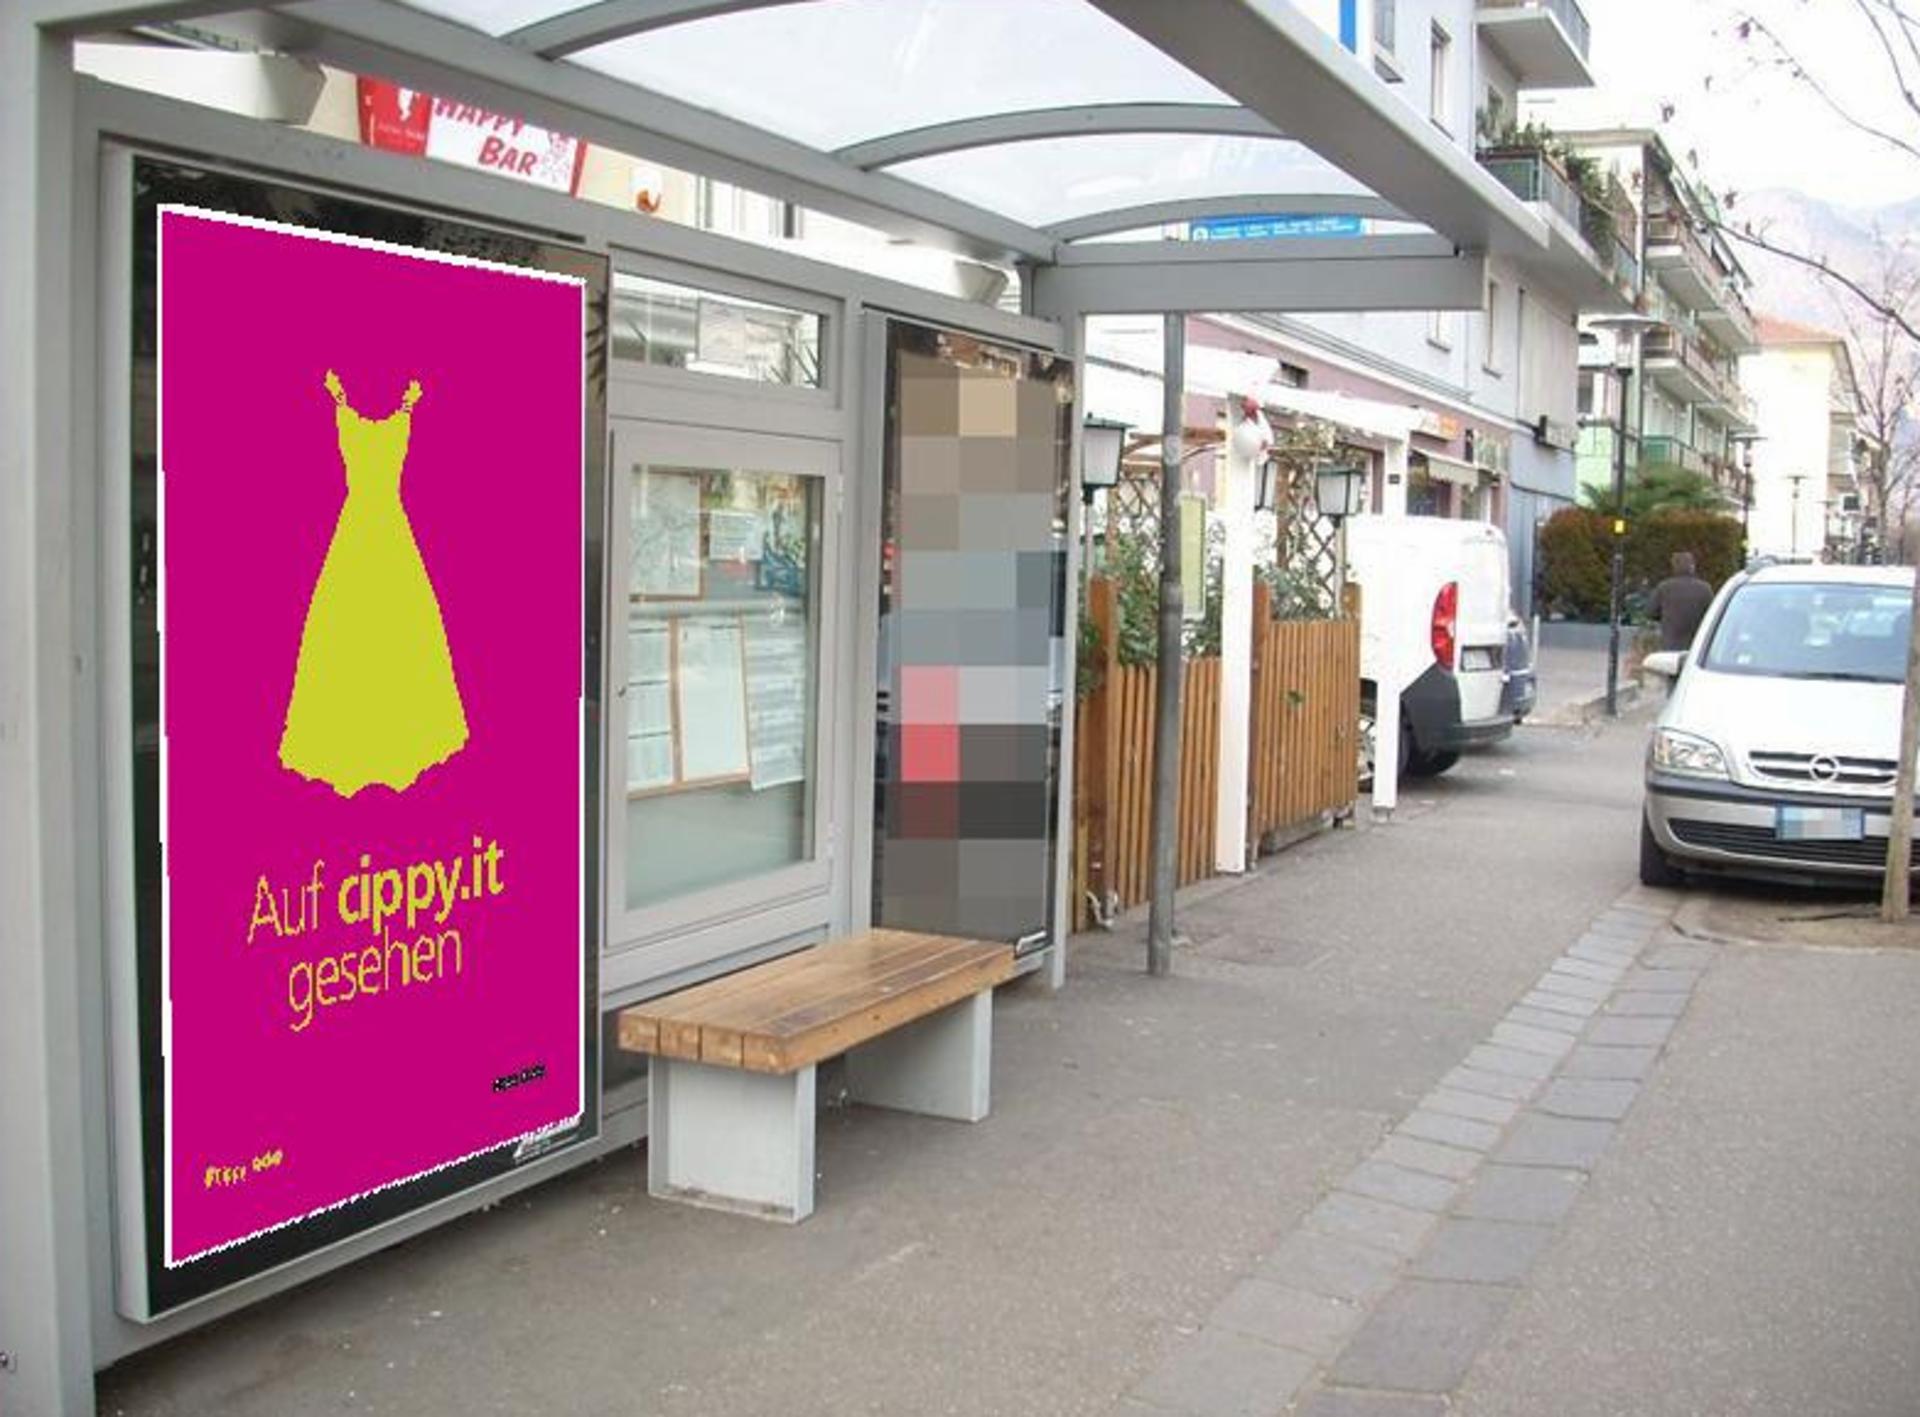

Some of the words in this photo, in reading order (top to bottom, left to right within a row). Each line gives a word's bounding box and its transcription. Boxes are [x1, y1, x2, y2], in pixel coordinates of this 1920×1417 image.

[478, 135, 538, 176] BAR
[247, 858, 325, 945] Auf
[337, 834, 504, 936] cippy.it
[289, 925, 463, 1032] gesehen
